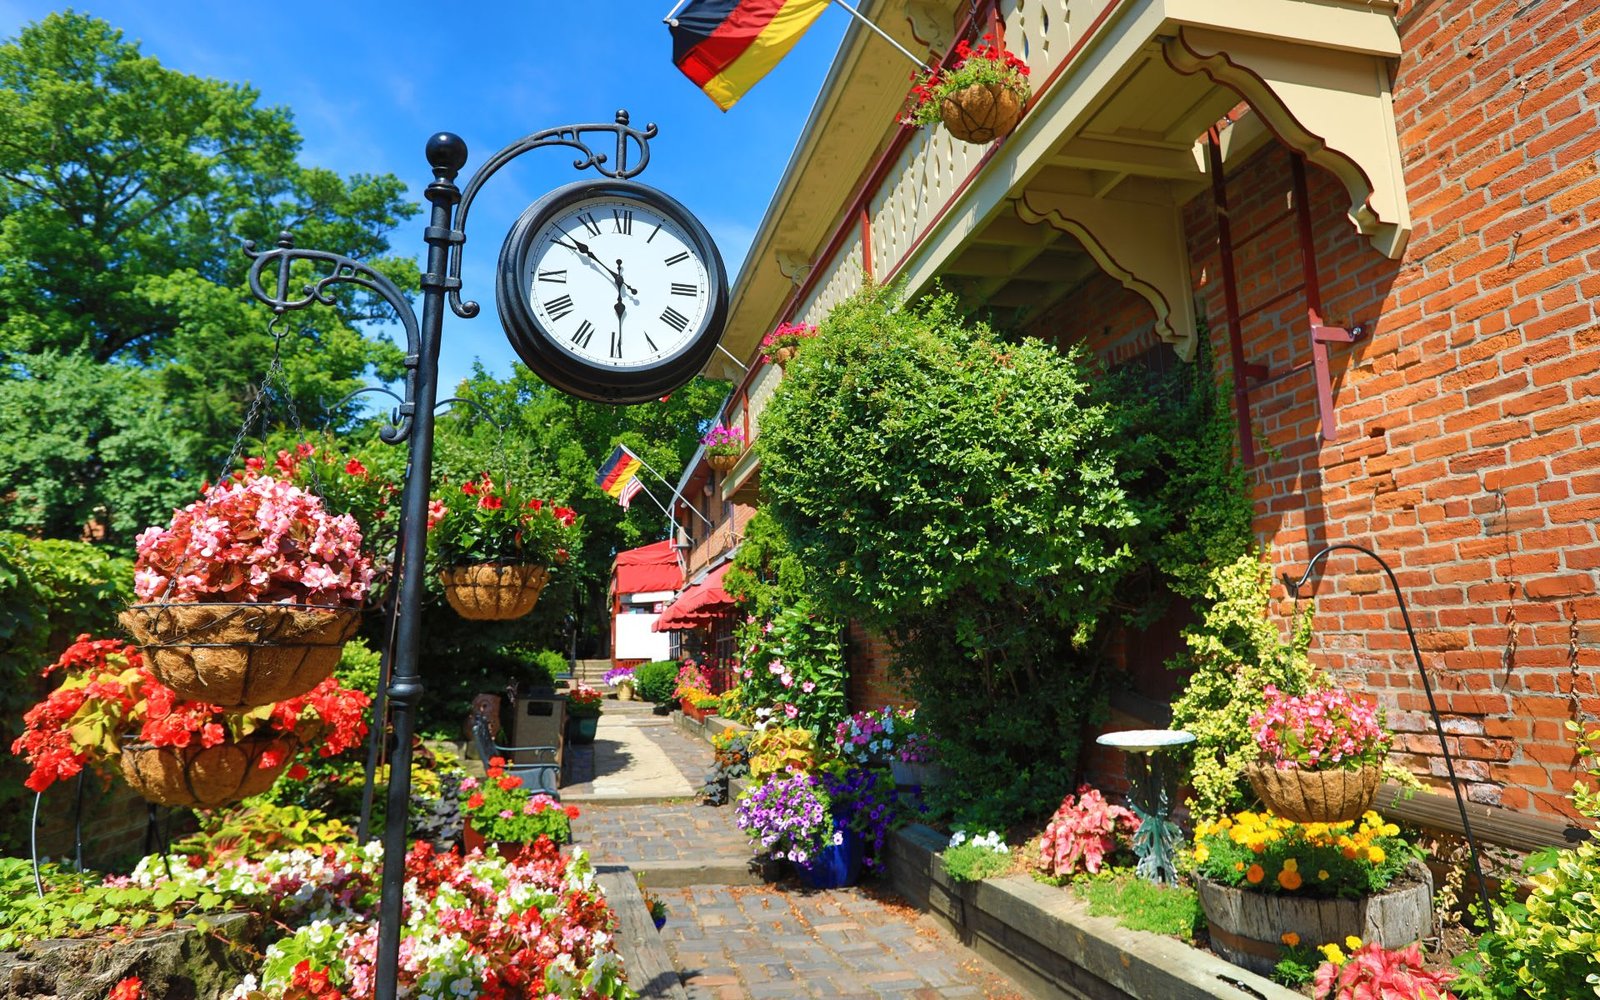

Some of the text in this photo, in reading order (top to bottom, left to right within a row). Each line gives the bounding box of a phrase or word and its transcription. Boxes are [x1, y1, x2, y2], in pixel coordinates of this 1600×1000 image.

[576, 212, 602, 239] XI
[611, 209, 633, 236] XII
[664, 251, 690, 267] II
[538, 268, 567, 284] IX
[670, 282, 698, 297] III
[543, 294, 574, 322] VIII
[659, 305, 690, 333] IIII
[570, 319, 596, 349] VII
